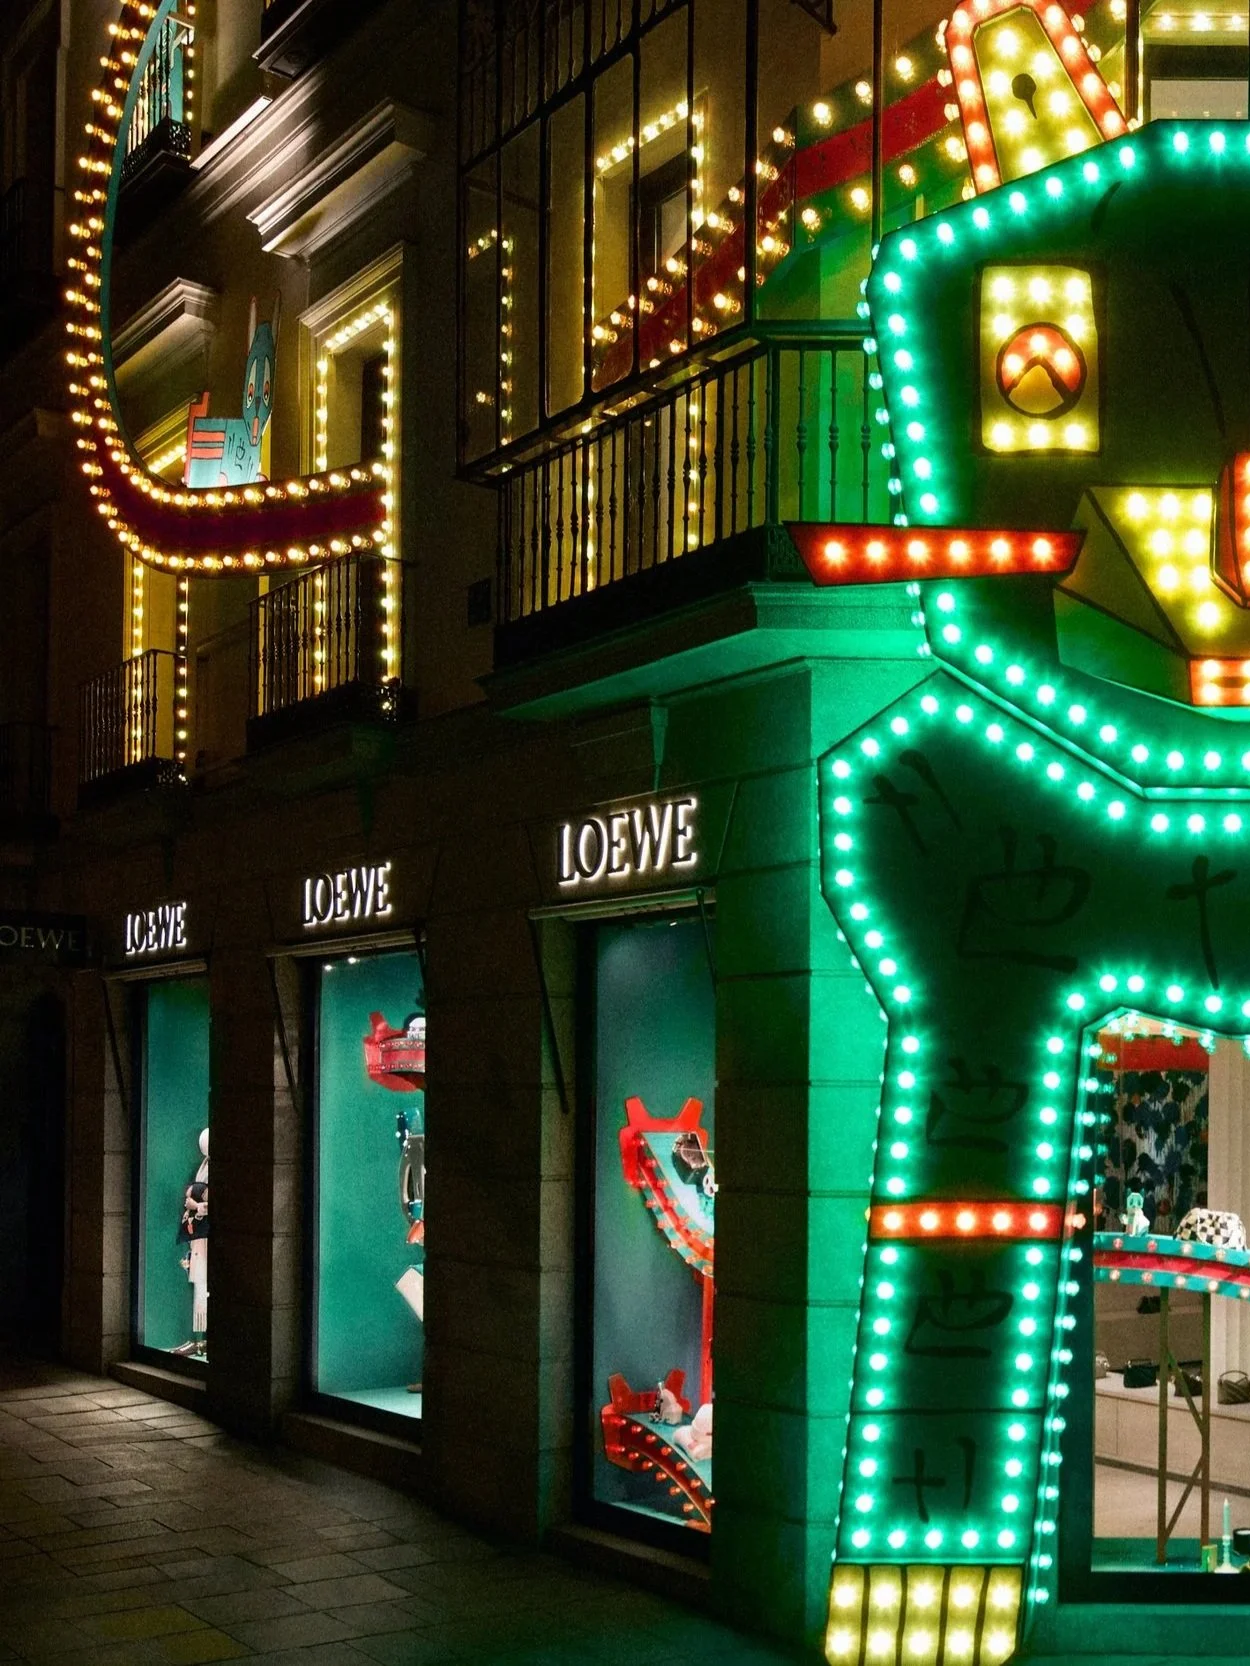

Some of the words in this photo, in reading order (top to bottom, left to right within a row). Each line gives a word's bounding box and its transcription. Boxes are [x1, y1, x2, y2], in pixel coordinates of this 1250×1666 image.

[557, 798, 698, 885] LOEWE
[303, 862, 392, 926] LOEWE
[0, 925, 81, 951] OEWE
[125, 902, 187, 955] LOEWE
